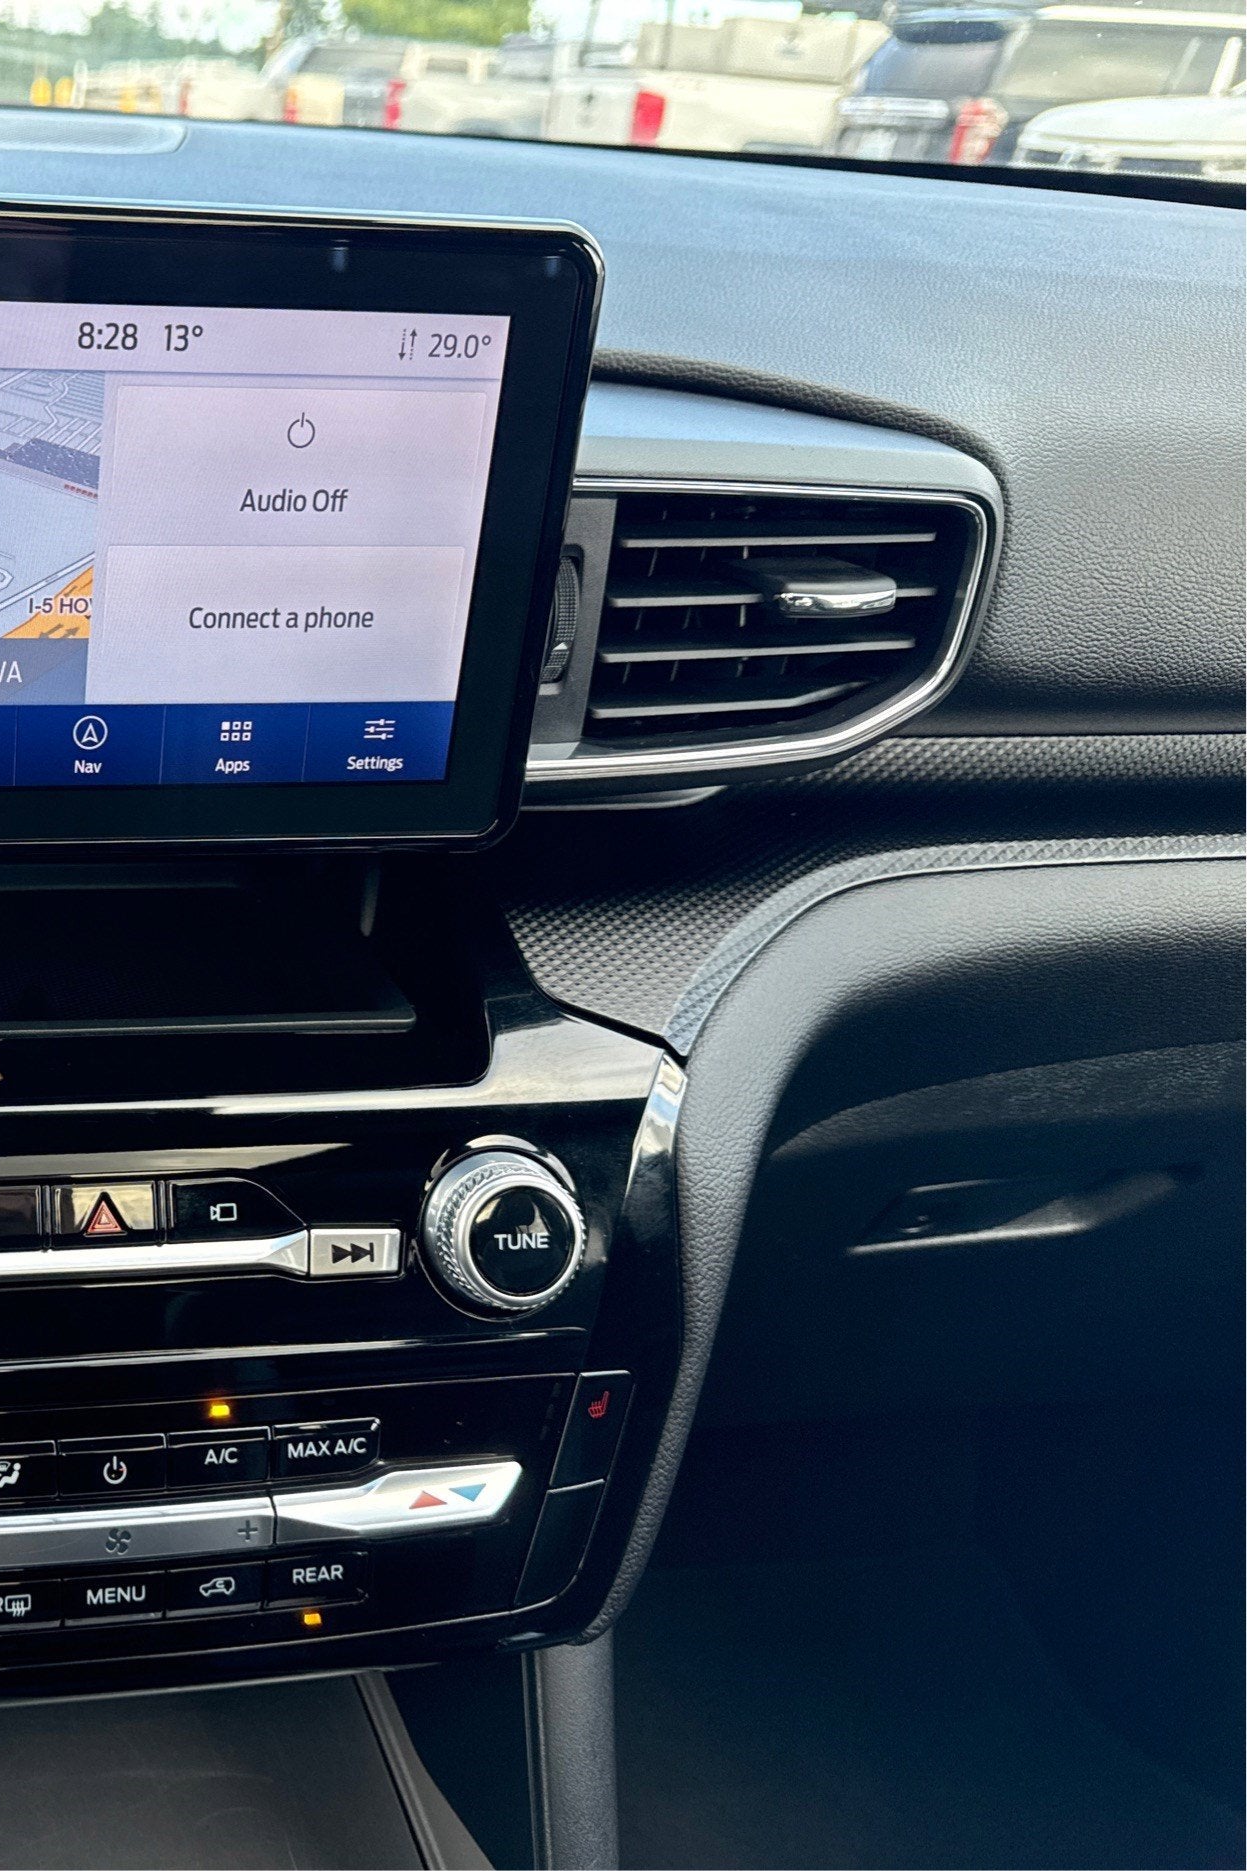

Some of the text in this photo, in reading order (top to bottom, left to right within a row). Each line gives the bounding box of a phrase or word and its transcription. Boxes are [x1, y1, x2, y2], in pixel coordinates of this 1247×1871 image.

[78, 322, 204, 352] 8:28 13°
[428, 333, 492, 359] 29.0°
[240, 489, 349, 512] Audio Off
[28, 597, 92, 613] I-5 HO
[188, 606, 374, 633] Connect a phone
[74, 760, 102, 774] Nav
[215, 759, 250, 774] Apps
[346, 755, 404, 772] Settings
[493, 1233, 550, 1250] TUNE
[204, 1447, 238, 1465] A/C
[287, 1437, 367, 1459] MAX A/C
[292, 1564, 344, 1584] REAR
[86, 1585, 146, 1606] MENU
